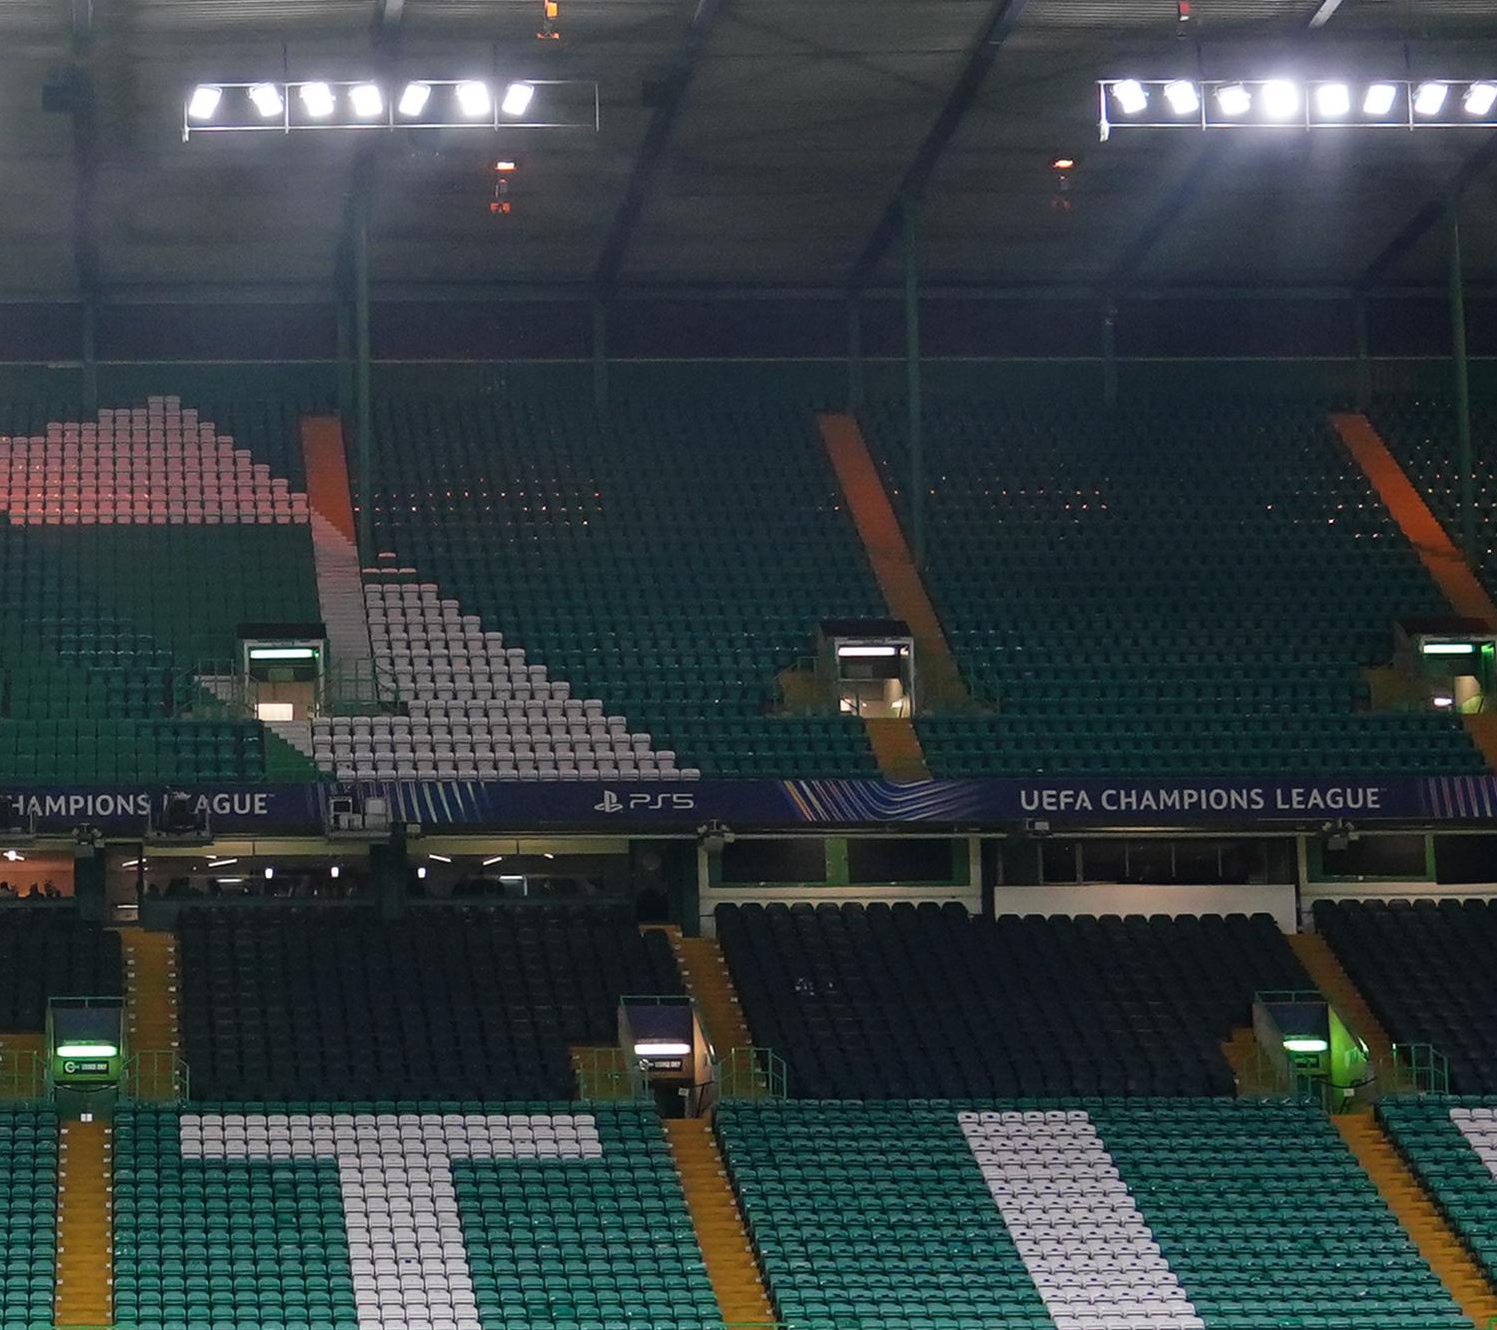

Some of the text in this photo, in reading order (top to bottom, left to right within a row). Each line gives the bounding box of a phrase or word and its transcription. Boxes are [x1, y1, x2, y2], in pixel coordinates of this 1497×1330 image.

[629, 793, 695, 810] PS5
[1020, 787, 1381, 812] UEFA CHAMPIONS LEAGUE
